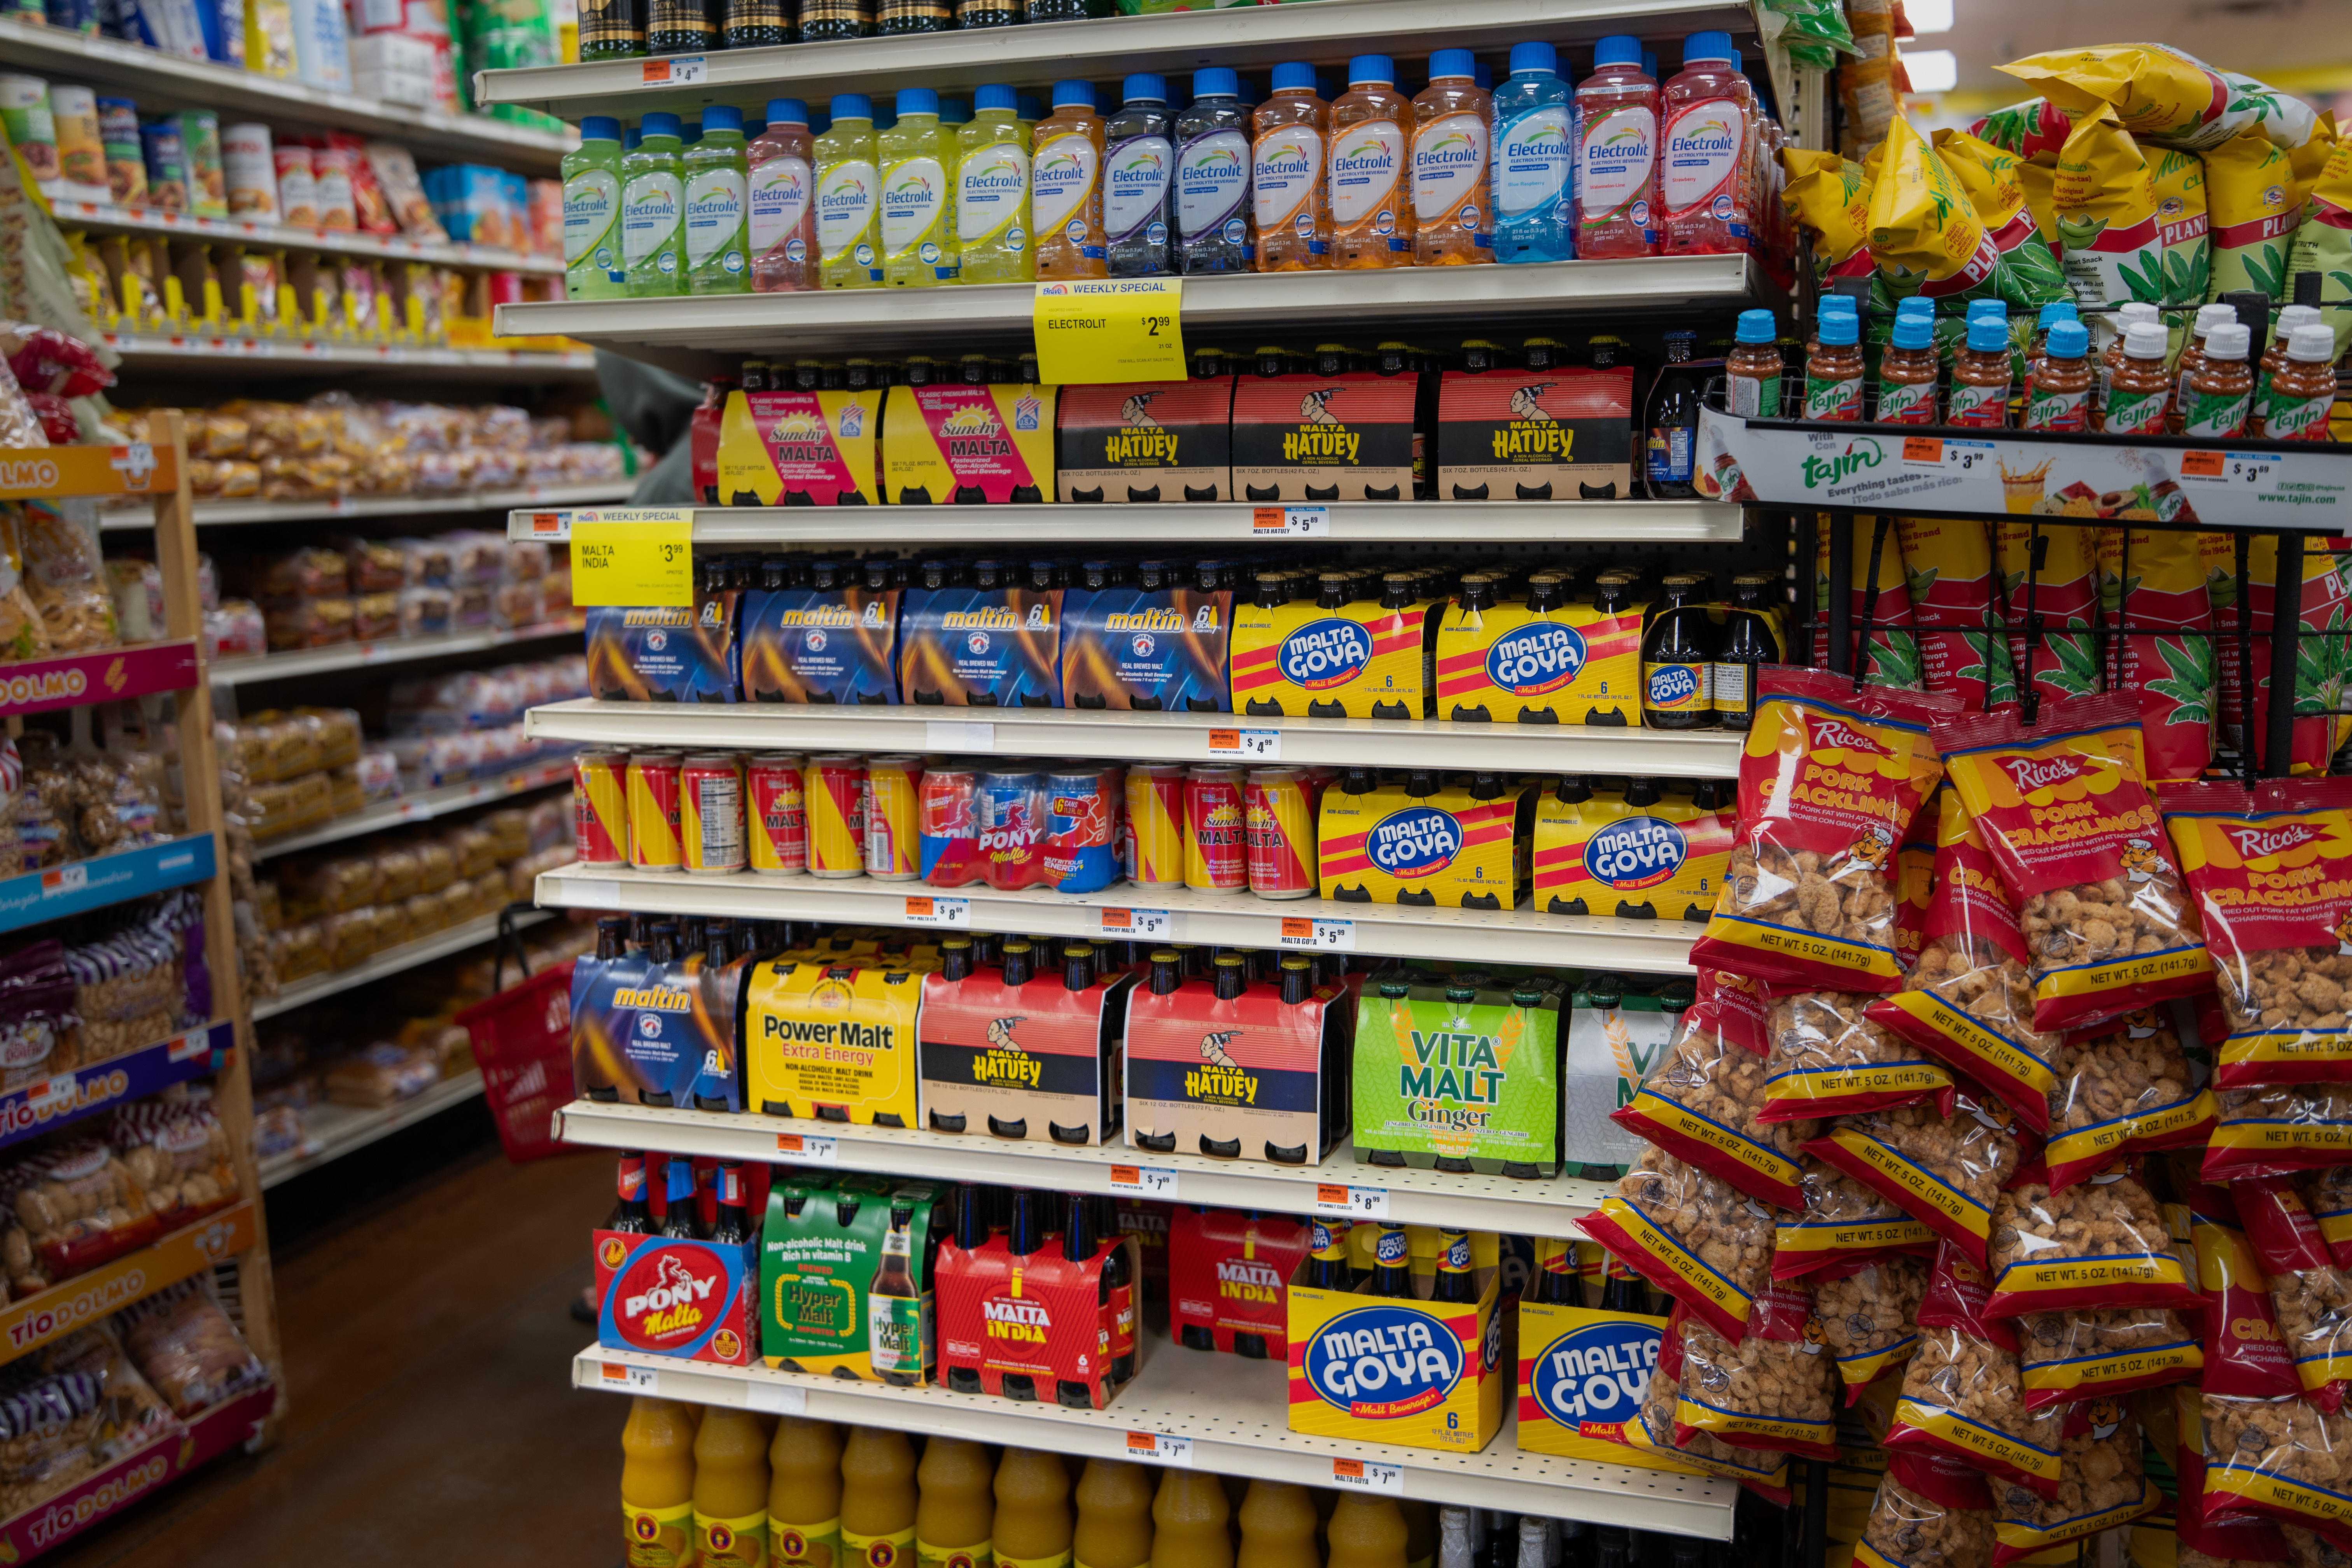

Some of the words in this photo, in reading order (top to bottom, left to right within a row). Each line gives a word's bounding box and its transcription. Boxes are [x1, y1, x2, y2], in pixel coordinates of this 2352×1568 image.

[1508, 142, 1570, 156] Electrolit
[1589, 144, 1648, 159] Electrolit
[1672, 137, 1733, 151] Electrolit
[1417, 150, 1478, 165] Electrolit
[1183, 164, 1242, 179] Electrolit
[966, 175, 1022, 188] Electrolit
[753, 188, 803, 201] Electrolit
[564, 201, 609, 213] Electrolit
[1074, 284, 1118, 293] WEEKLY
[1120, 283, 1166, 292] SPECIAL
[1048, 319, 1106, 329] ELECTROLIT
[939, 421, 1001, 438] Sunchy
[1300, 424, 1346, 432] MALTA
[1808, 432, 1833, 441] With
[950, 440, 1011, 456] MALTA
[1283, 432, 1360, 460] HATUEY
[1493, 429, 1573, 458] HATUEY
[1815, 441, 1836, 450] Con
[1828, 479, 1886, 497] Everything
[1888, 475, 1922, 486] tastes
[1852, 491, 1882, 504] ¡Todo
[1885, 486, 1910, 498] sabe
[1913, 481, 1934, 494] más
[2258, 494, 2336, 505] www.tajin.com
[642, 512, 681, 520] SPECIAL
[582, 546, 614, 556] MALTA
[583, 558, 609, 568] INDIA
[1196, 606, 1209, 621] 6
[1290, 626, 1354, 655] MALTA
[1499, 630, 1568, 660] MALTA
[1288, 641, 1365, 677] GOYA
[1497, 645, 1579, 684] GOYA
[1311, 680, 1326, 688] Malt
[1328, 671, 1353, 686] Beverage
[1386, 676, 1392, 688] 6
[1811, 722, 1876, 748] Rico's
[1804, 764, 1872, 793] PORK
[2006, 758, 2079, 789] Rico's
[2030, 800, 2099, 824] PORK
[2000, 804, 2157, 848] CRACKLINGS
[978, 828, 1043, 851] PONY
[2051, 844, 2071, 852] PORK
[2086, 836, 2104, 845] WITH
[2105, 832, 2140, 840] ATTACHED
[990, 847, 1025, 863] Malta
[1761, 933, 1782, 946] NET
[1785, 937, 1800, 950] WT.
[1803, 942, 1809, 952] 5
[1812, 945, 1829, 958] OZ.
[1832, 948, 1871, 967] (141.7g)
[764, 1014, 838, 1042] Power
[840, 1021, 894, 1050] Malt
[782, 1043, 821, 1059] Extra
[824, 1045, 874, 1067] Energy
[1410, 1031, 1499, 1069] VITA
[785, 1063, 833, 1074] NON-ALCOHOLIC
[836, 1068, 852, 1076] MALT
[854, 1070, 873, 1078] DRINK
[1200, 1065, 1244, 1075] MALTA
[1185, 1071, 1258, 1104] HATUEY
[1400, 1064, 1506, 1104] MALT
[1407, 1100, 1491, 1132] Ginger
[767, 1237, 822, 1252] Non-alcoholic
[824, 1238, 844, 1249] Malt
[846, 1240, 866, 1253] drink
[782, 1251, 799, 1262] Rich
[801, 1252, 809, 1261] in
[812, 1252, 842, 1261] vitamin
[845, 1253, 851, 1262] B
[2036, 1270, 2056, 1283] NET
[2058, 1269, 2079, 1281] WT.
[2081, 1269, 2088, 1279] 5
[2090, 1267, 2109, 1278] OZ.
[2112, 1266, 2154, 1278] (141.7g)
[625, 1275, 717, 1317] PONY
[644, 1304, 702, 1337] Malta
[982, 1302, 1051, 1326] MALTA
[873, 1315, 915, 1337] Hyper
[880, 1335, 910, 1352] Malt
[1324, 1322, 1432, 1360] MALTA
[1323, 1347, 1452, 1398] GOYA
[1447, 1412, 1458, 1429] 6
